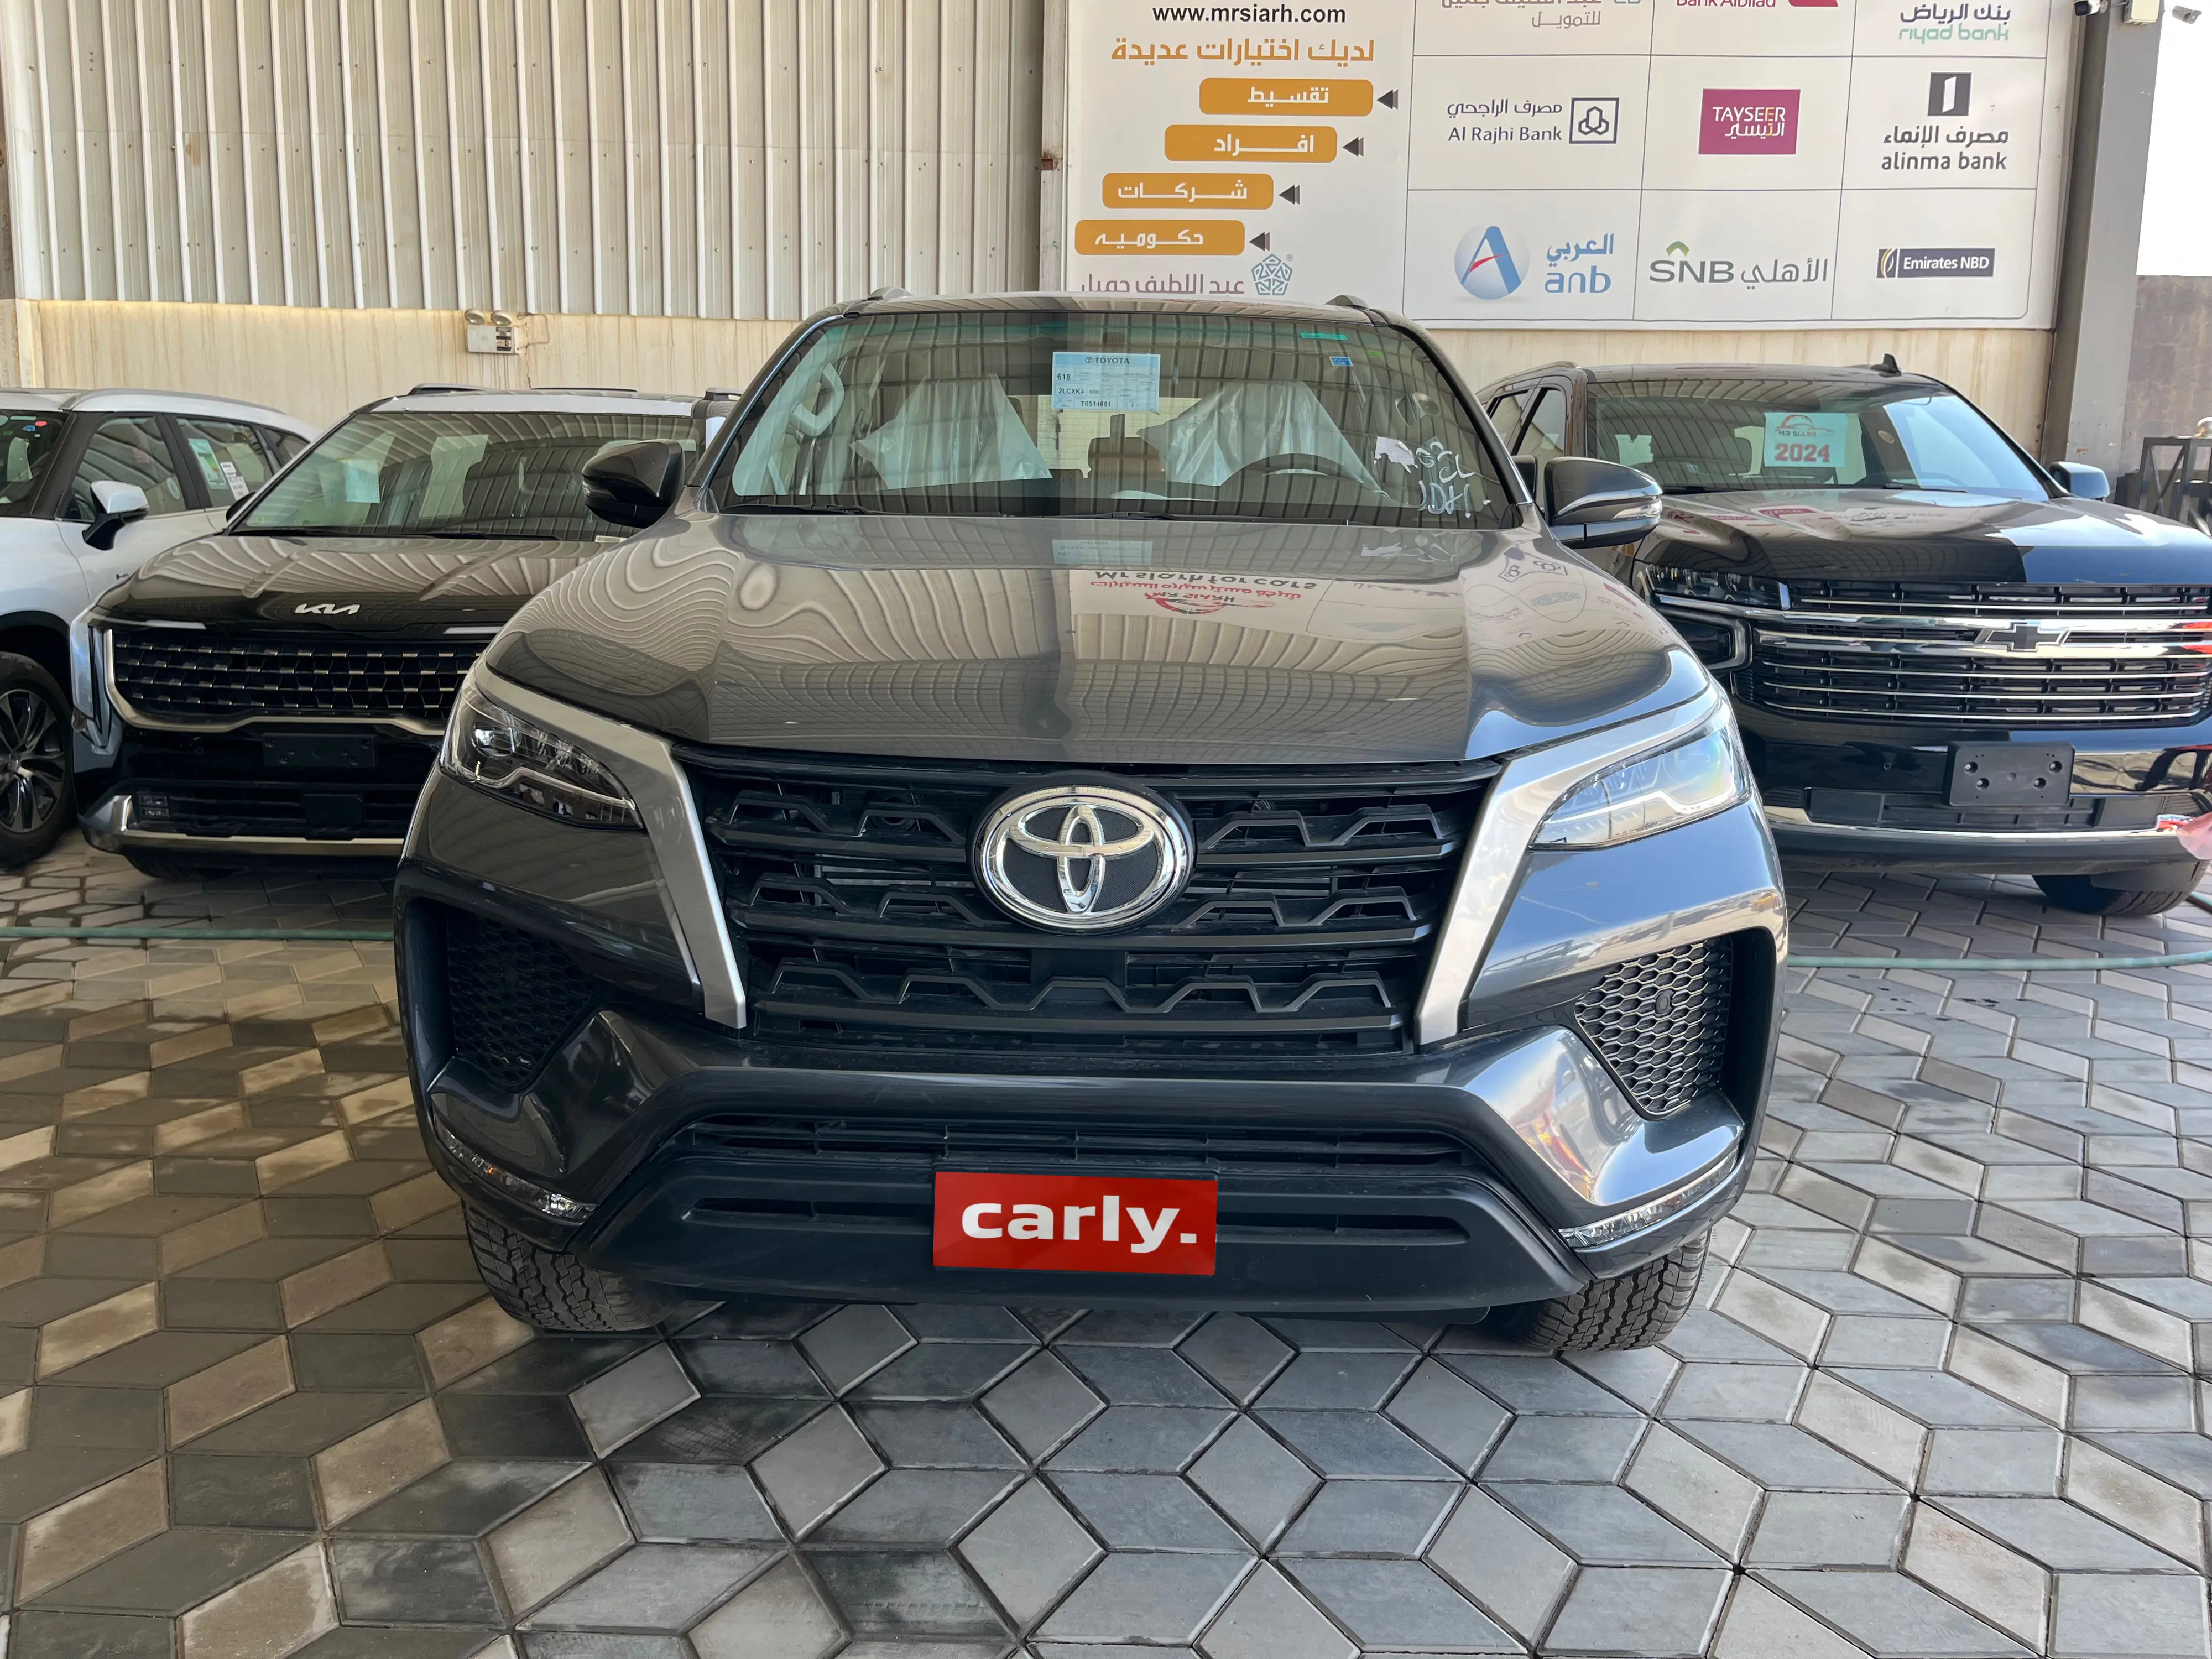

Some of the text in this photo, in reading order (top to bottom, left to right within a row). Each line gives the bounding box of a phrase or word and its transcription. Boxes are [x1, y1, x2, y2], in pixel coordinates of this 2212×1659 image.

[1152, 4, 1347, 23] www.mrsiarh.com
[1532, 11, 1601, 29] للتمويل
[1900, 3, 2011, 25] بنك الرياض
[1898, 22, 2010, 45] riyad bank
[1111, 37, 1374, 67] لديك اختيارات عديدة
[1246, 86, 1329, 108] تقسيط
[1447, 98, 1563, 119] مصرف الراجحي
[1712, 107, 1786, 122] TAYSEER
[1448, 127, 1563, 145] Al Rajhi Bank
[1724, 122, 1785, 140] التيسير
[1882, 124, 2009, 149] مصرف الإنماء
[1214, 134, 1314, 157] افراد
[1881, 151, 2007, 171] alinma bank
[1118, 179, 1248, 203] شركات
[1094, 231, 1204, 249] حكوميه
[1545, 233, 1615, 268] العربي
[1649, 260, 1734, 284] SNB
[1740, 258, 1829, 290] الأهلي
[1903, 255, 1990, 271] Emirates NBD
[1544, 265, 1612, 294] anb
[1774, 443, 1830, 463] 2024
[962, 1194, 1197, 1254] carly.
